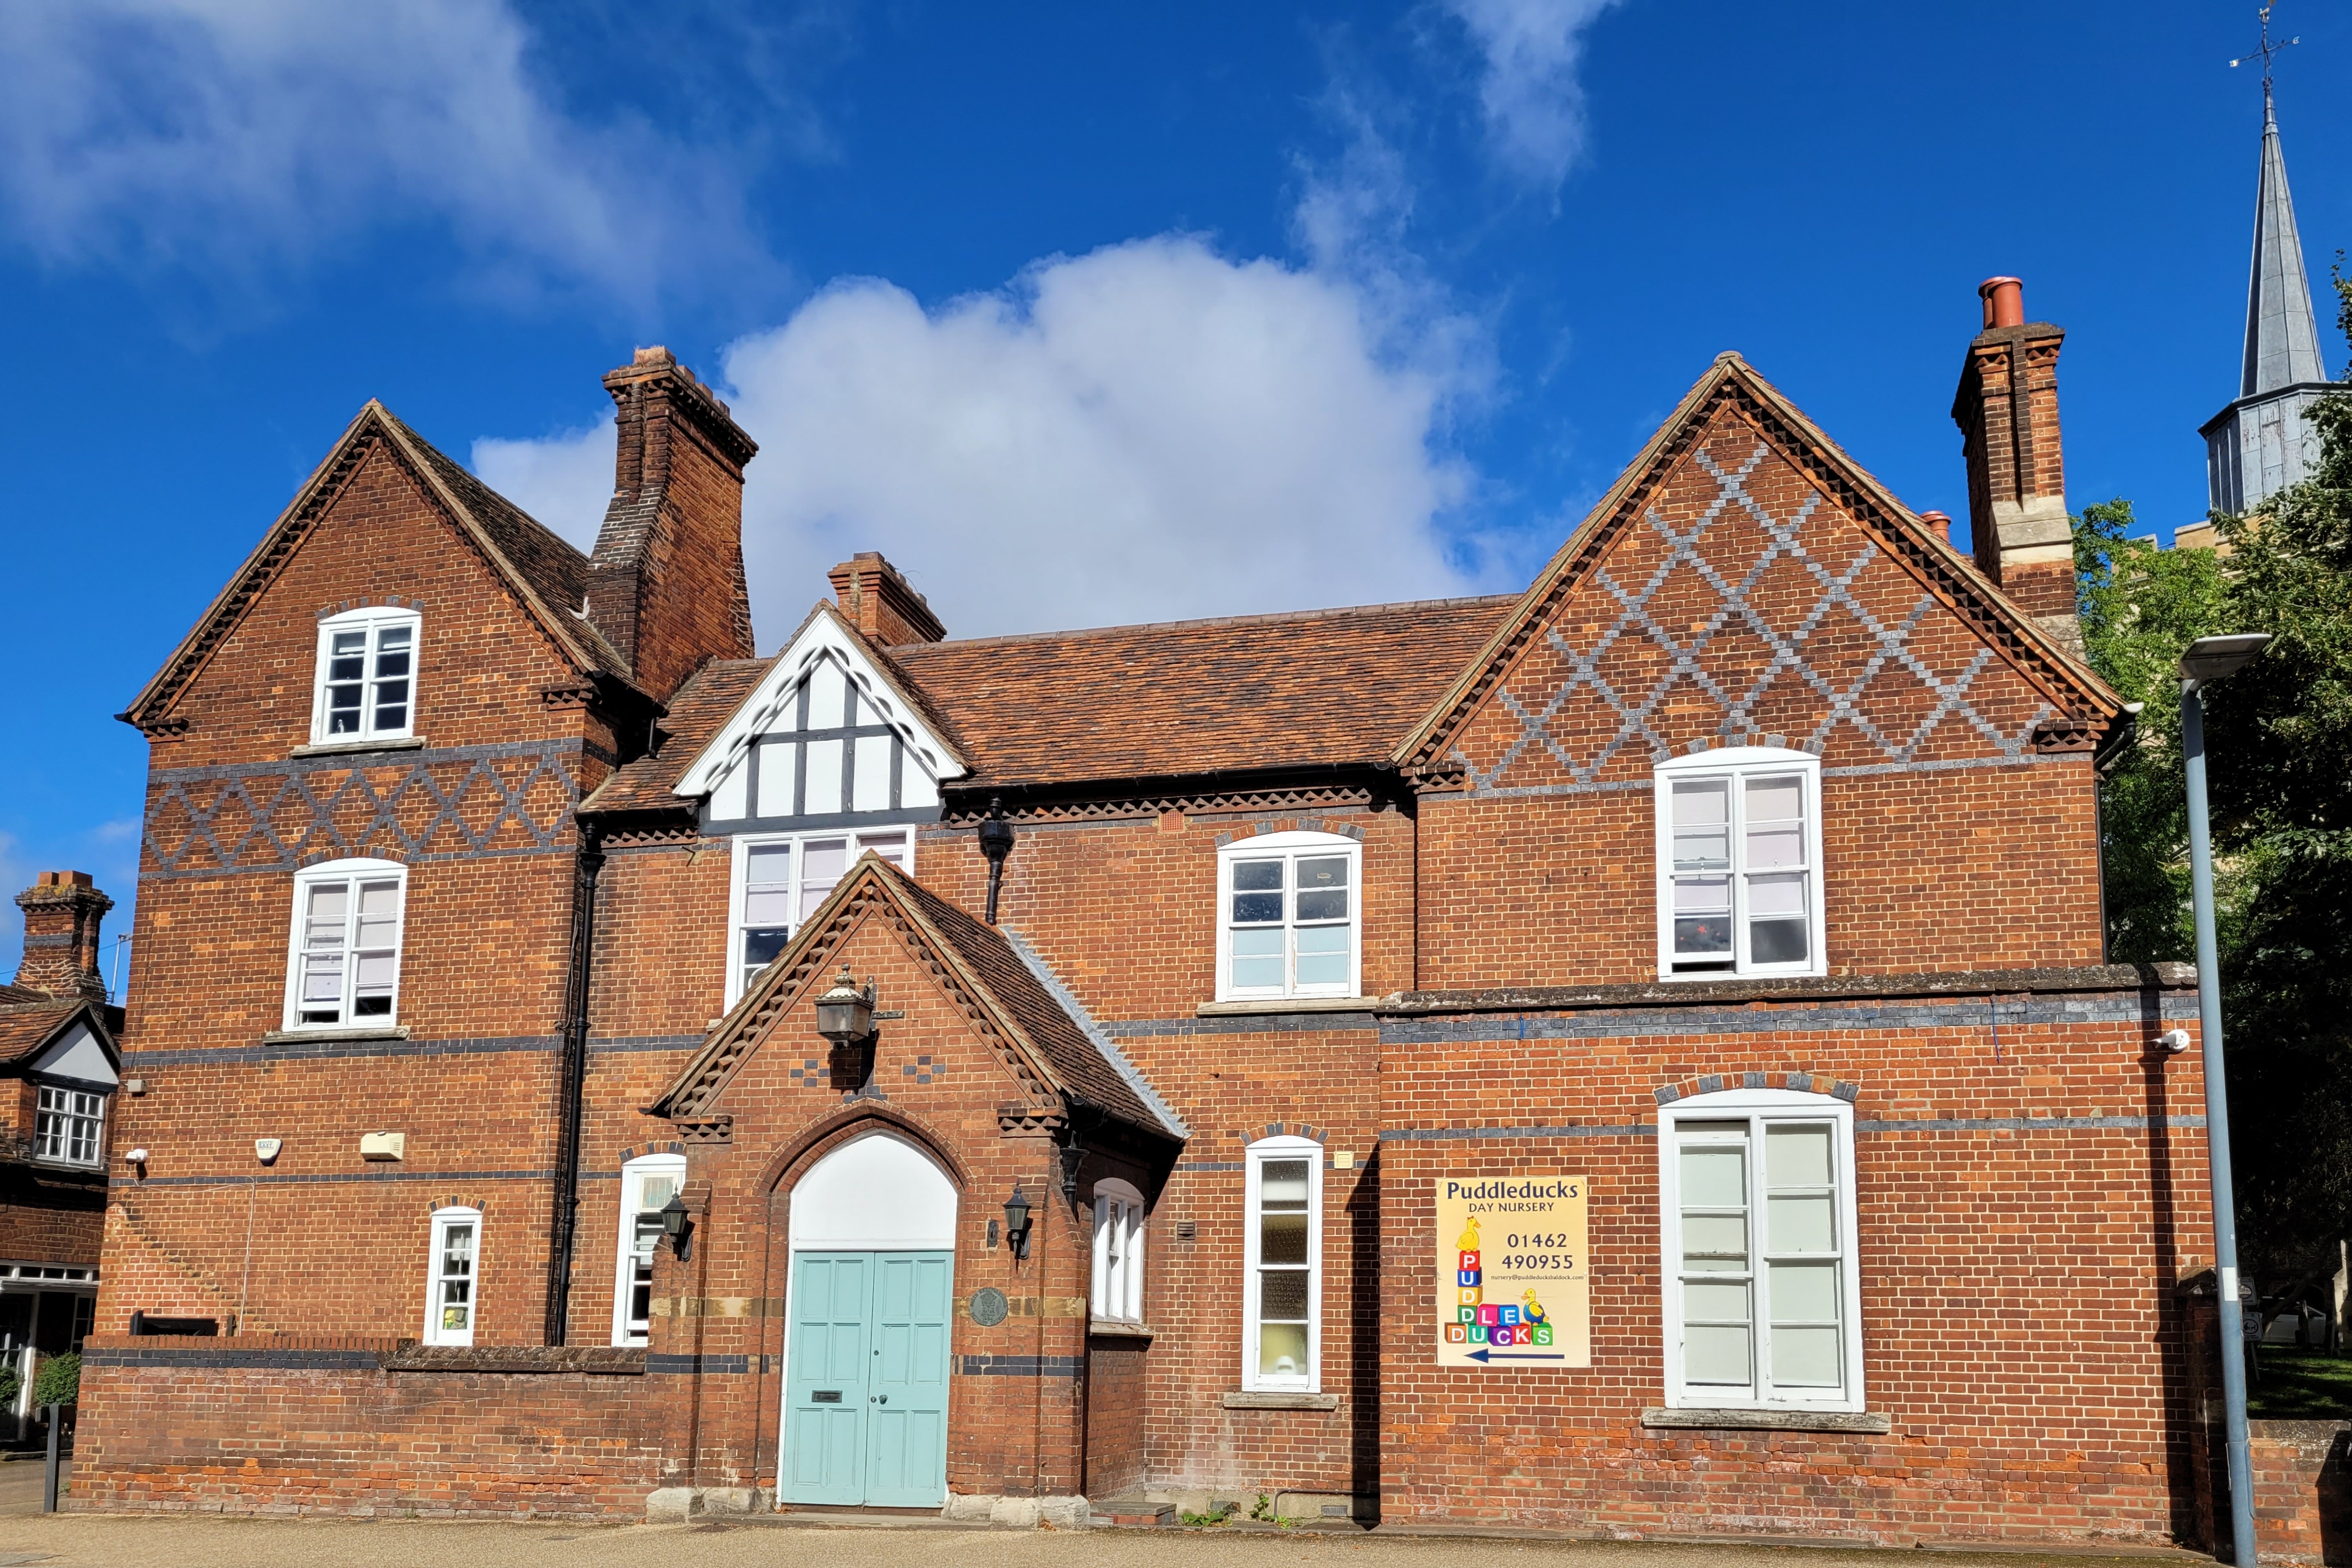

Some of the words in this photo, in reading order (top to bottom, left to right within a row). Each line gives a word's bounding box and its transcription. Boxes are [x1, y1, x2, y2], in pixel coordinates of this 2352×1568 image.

[1447, 1181, 1578, 1199] Puddleducks
[1469, 1203, 1494, 1212] DAY
[1498, 1202, 1555, 1212] NURSERY
[1507, 1233, 1567, 1248] 01462
[1502, 1255, 1573, 1269] 490955
[1451, 1328, 1550, 1345] DUCKS
